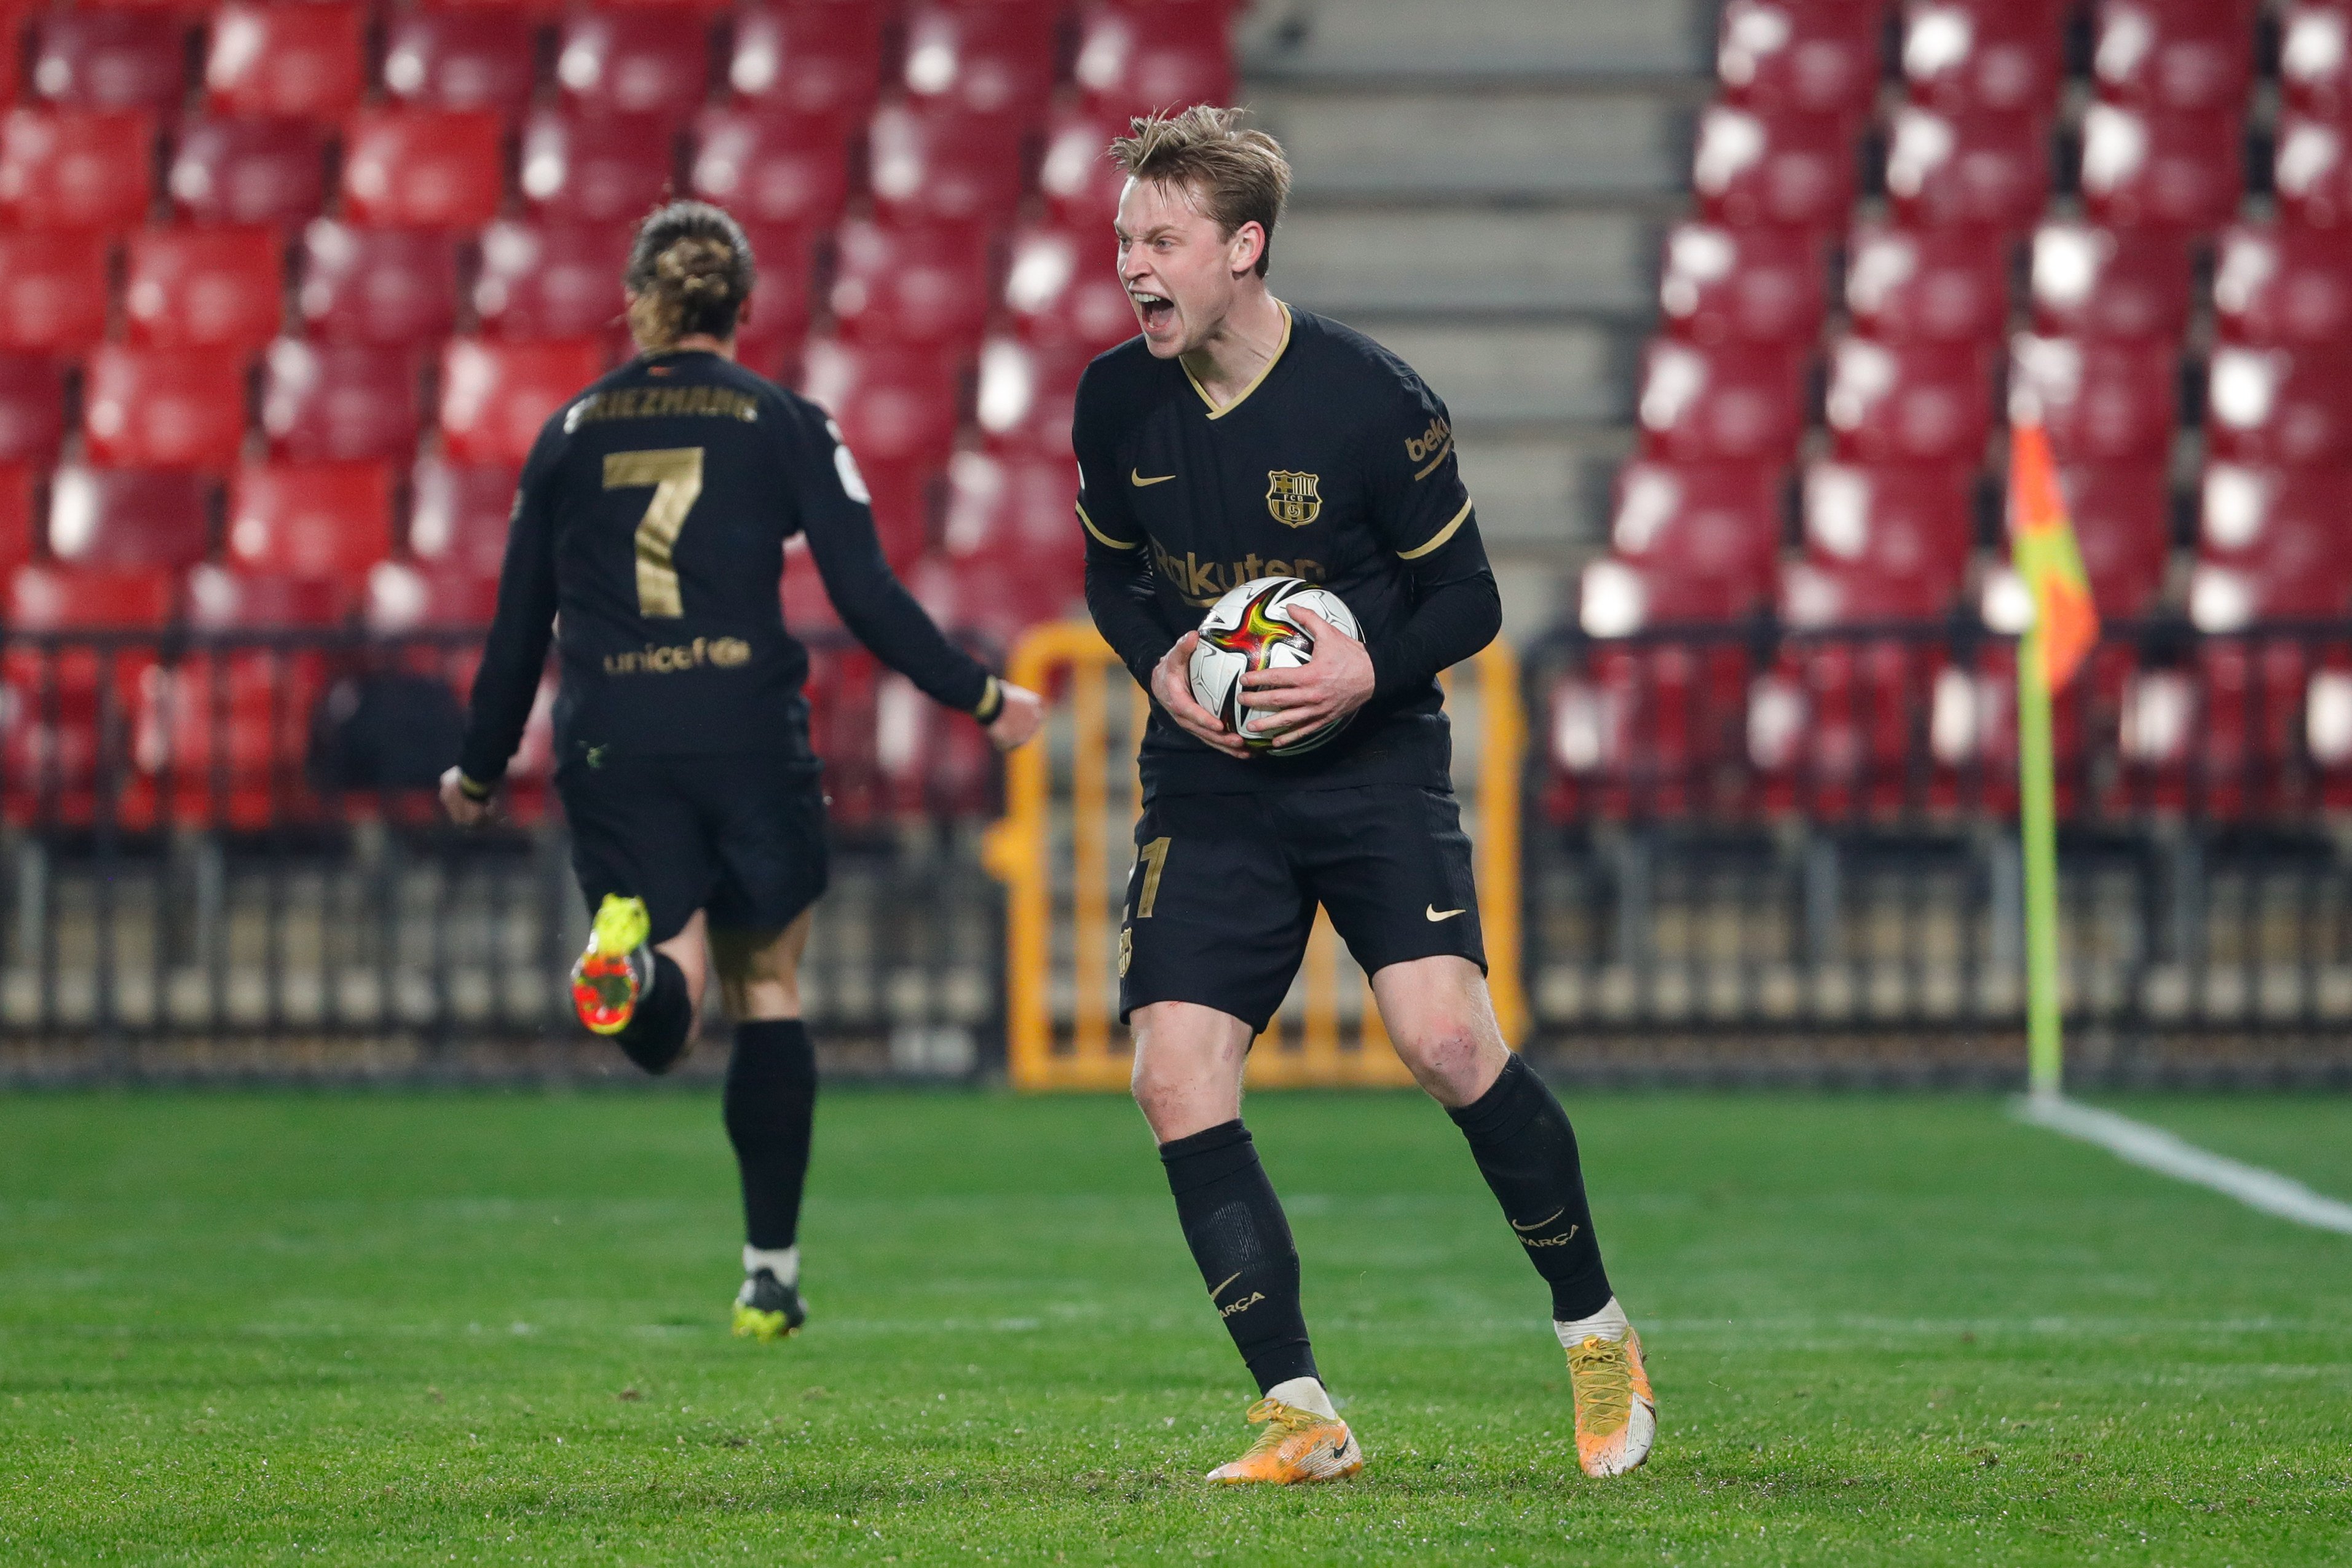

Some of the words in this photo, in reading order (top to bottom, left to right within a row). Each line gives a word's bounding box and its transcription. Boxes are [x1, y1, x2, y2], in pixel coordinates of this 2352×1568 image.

[602, 447, 704, 619] 7
[603, 636, 706, 675] unicef
[1123, 837, 1172, 921] 1
[1219, 1291, 1266, 1318] ARÇA
